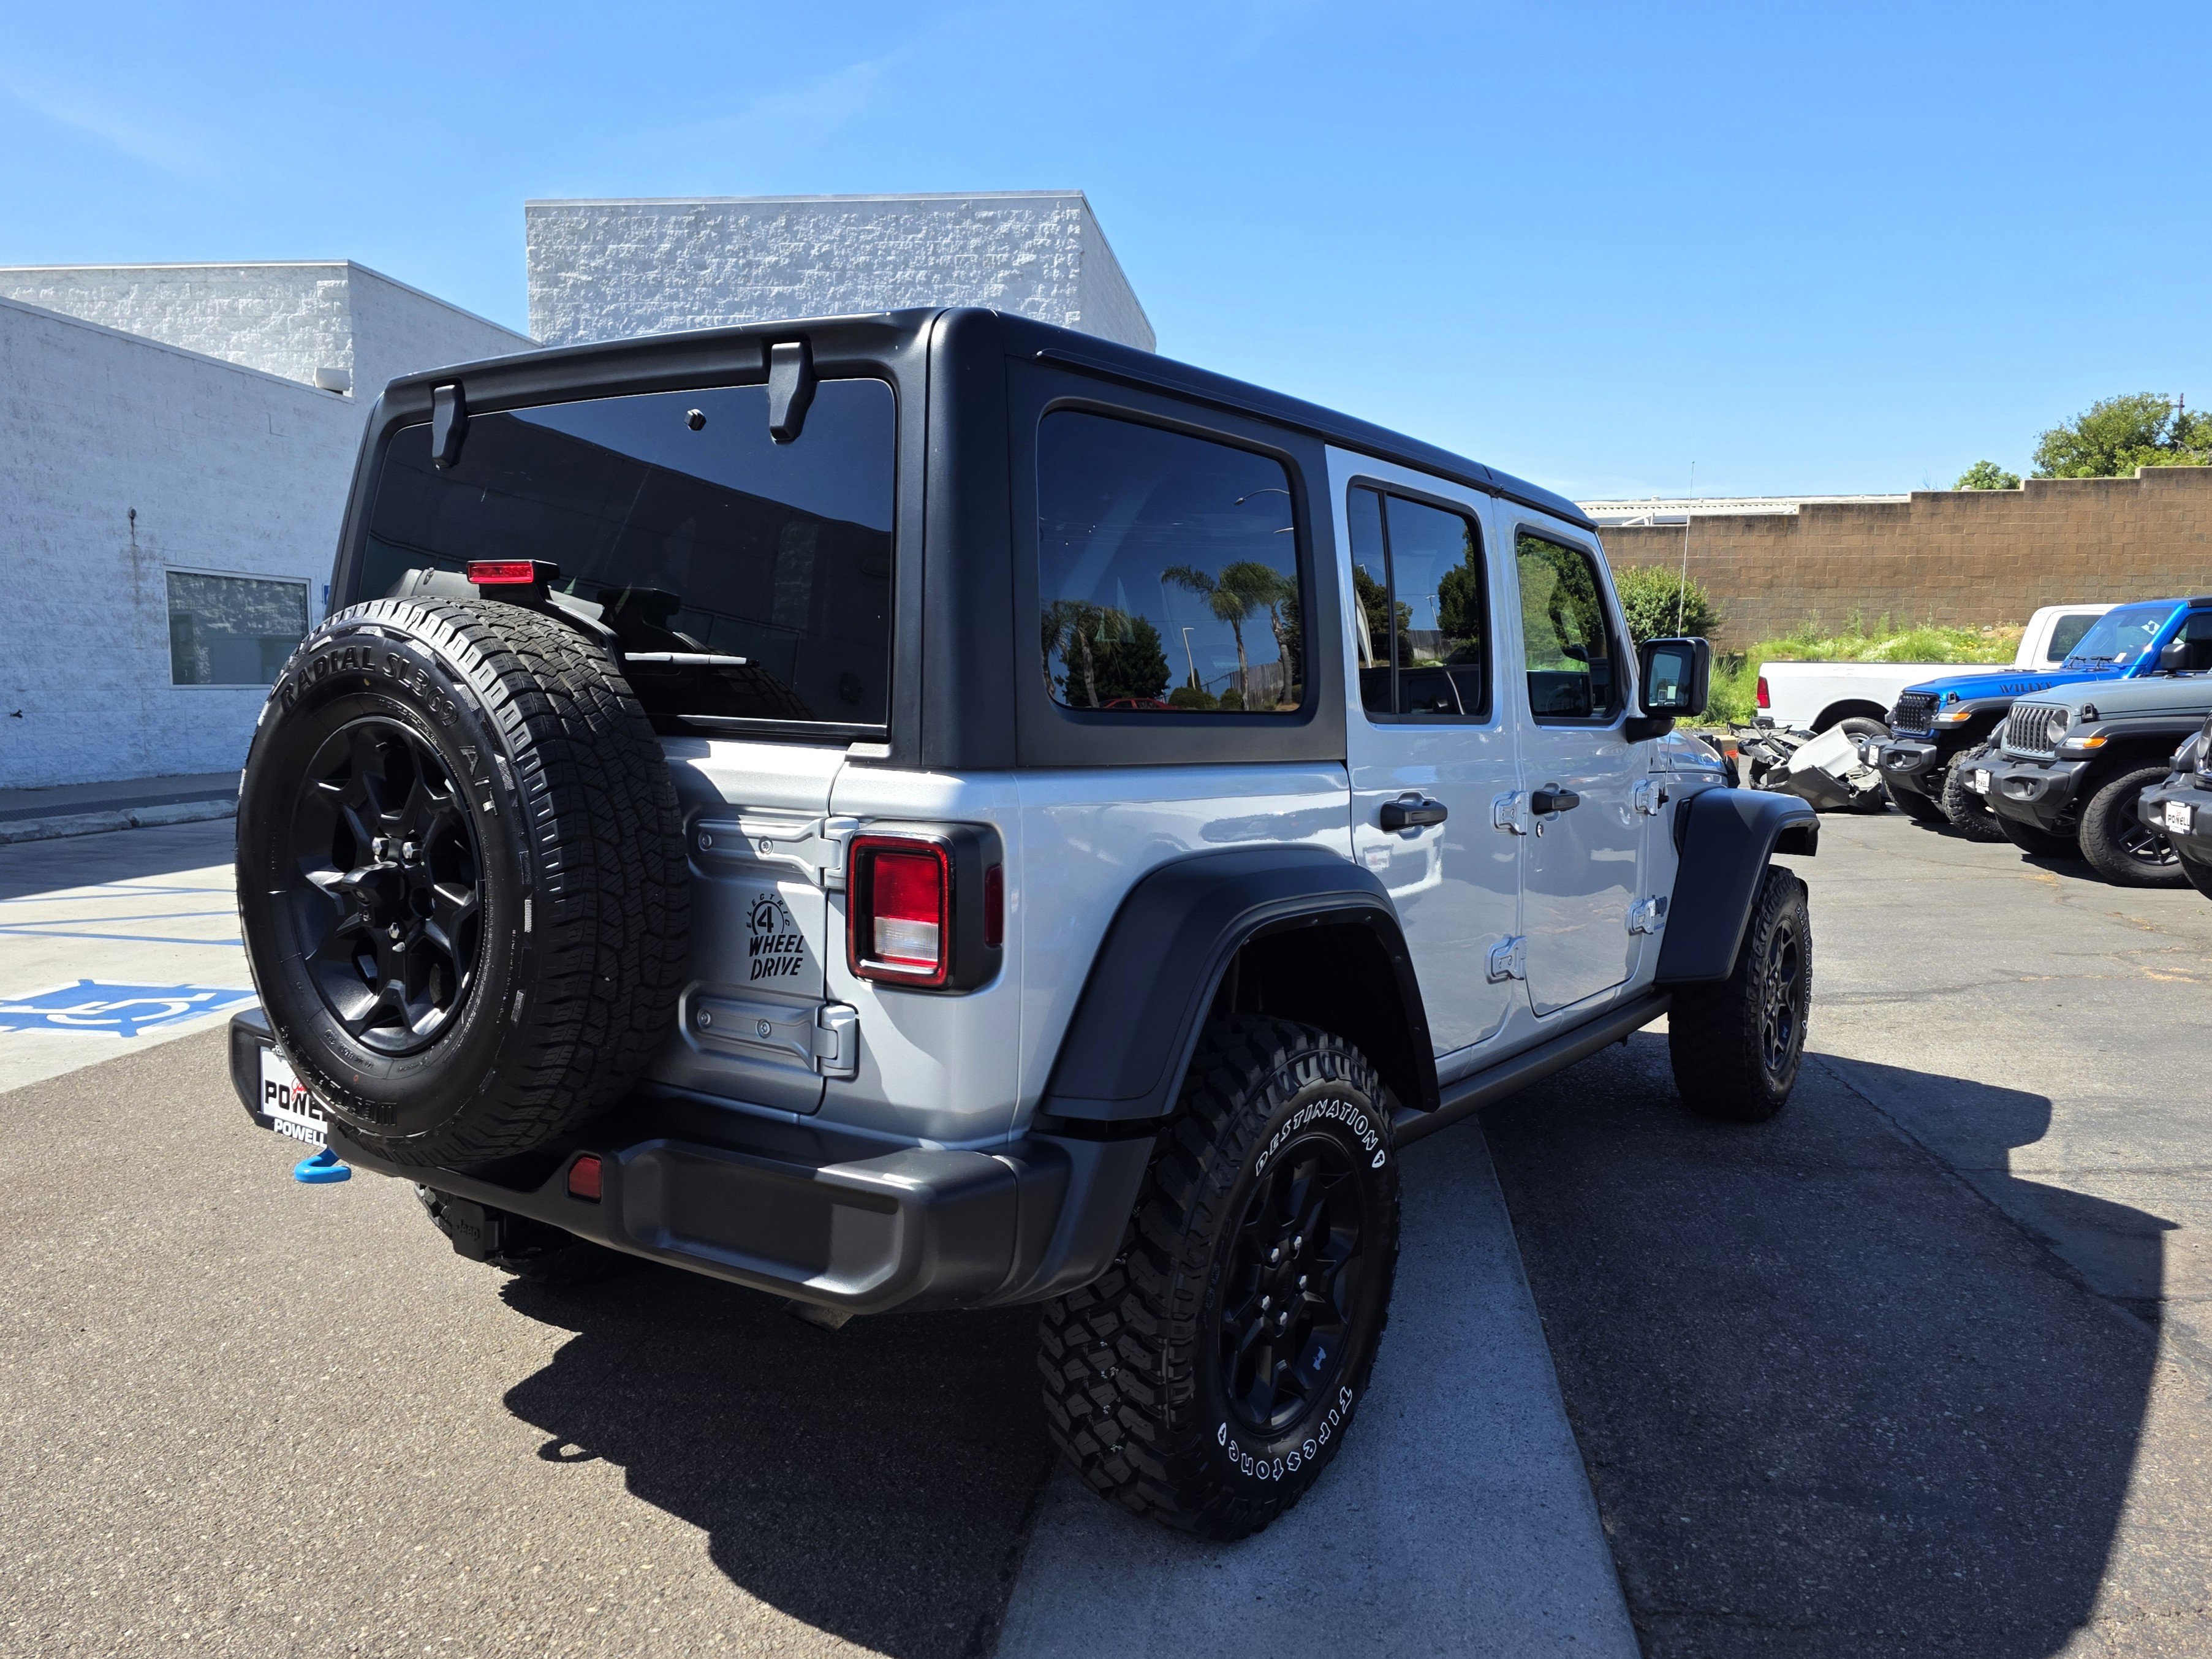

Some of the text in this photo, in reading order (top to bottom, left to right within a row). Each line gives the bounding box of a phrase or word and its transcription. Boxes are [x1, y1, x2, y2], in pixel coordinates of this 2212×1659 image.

[279, 645, 376, 715] RADIAL
[383, 651, 460, 727] SL369
[2168, 814, 2190, 826] POWELL
[746, 893, 790, 928] ELECTRIC
[757, 906, 774, 933] 4
[749, 934, 804, 957] WHEEL
[750, 956, 803, 981] DRIVE
[274, 1118, 327, 1148] POWELL
[1256, 1098, 1379, 1176] DESTINATION
[456, 1218, 480, 1241] Jeep
